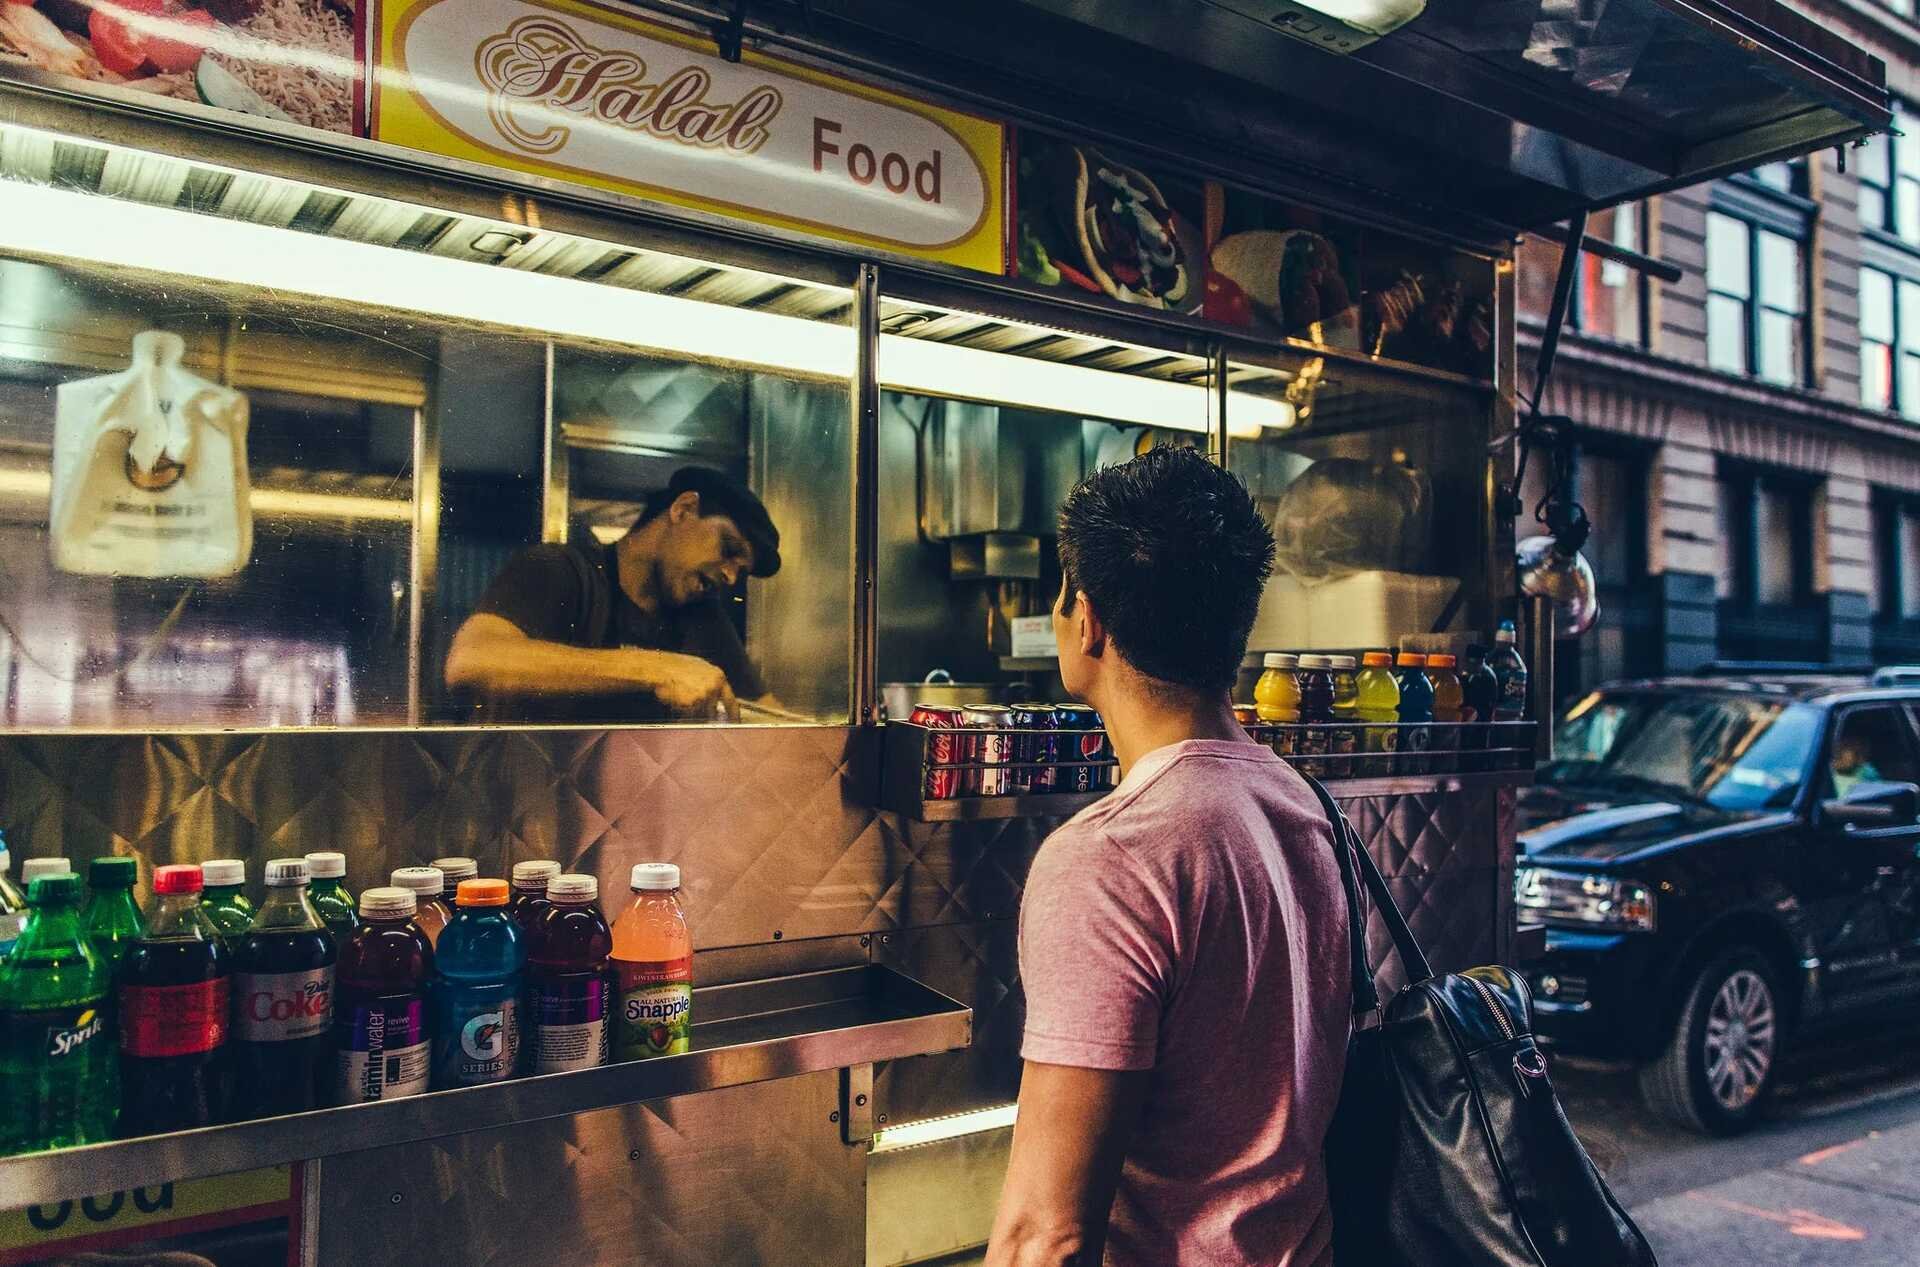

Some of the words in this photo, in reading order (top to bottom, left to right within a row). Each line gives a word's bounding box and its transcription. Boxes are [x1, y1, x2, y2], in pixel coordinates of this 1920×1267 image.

[475, 15, 783, 154] Halal
[811, 117, 942, 204] Food
[1078, 766, 1088, 792] eps
[247, 991, 330, 1021] Coke
[626, 996, 689, 1021] Snapple
[463, 1060, 504, 1073] SERIES
